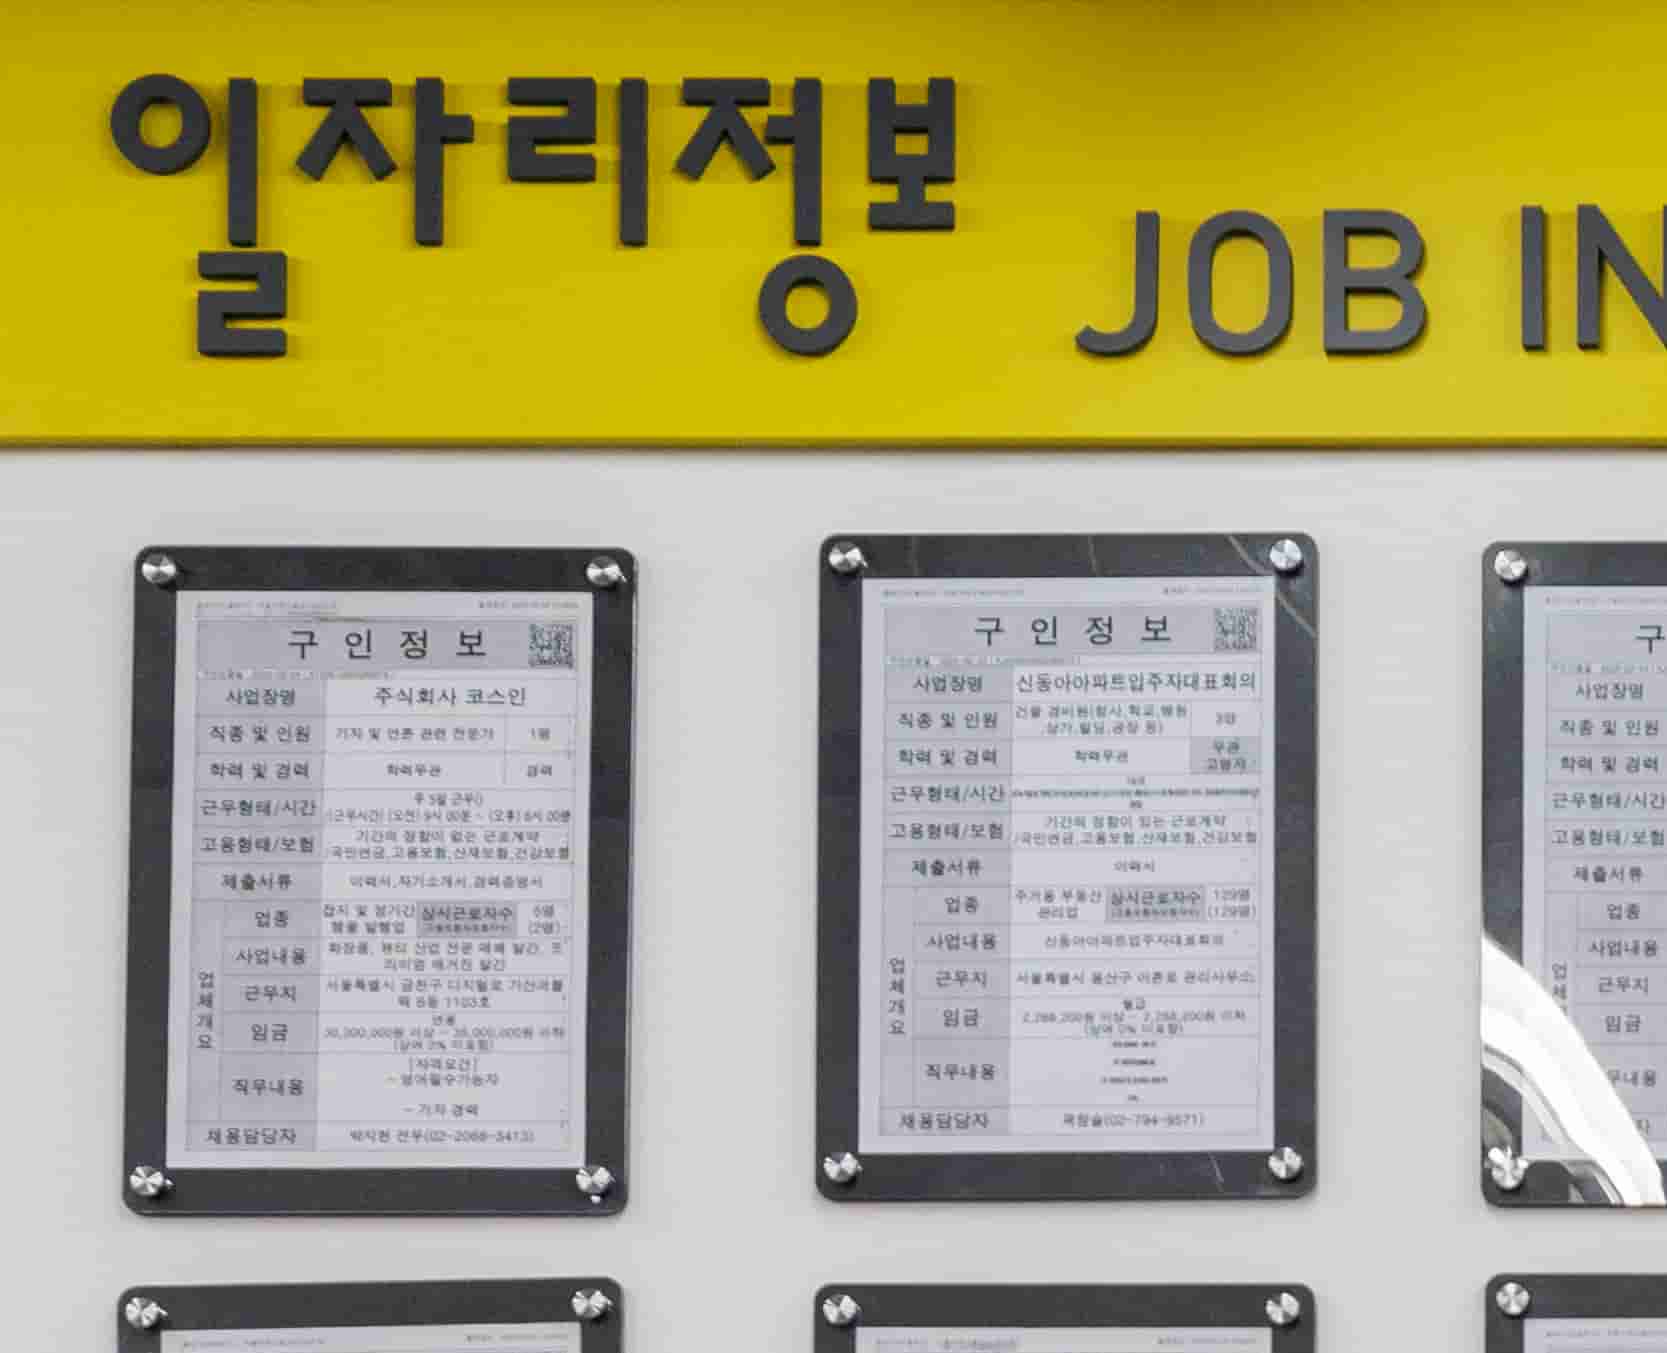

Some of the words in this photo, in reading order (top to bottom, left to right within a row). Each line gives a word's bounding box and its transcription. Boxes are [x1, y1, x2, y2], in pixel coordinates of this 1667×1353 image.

[110, 73, 959, 361] 일자리정보
[1076, 208, 1428, 358] JOB
[911, 673, 983, 694] 사업장명
[1575, 681, 1644, 702] 사업장명
[225, 687, 296, 707] 사업장명
[374, 686, 457, 708] 주식회사
[463, 687, 526, 707] 코스인
[890, 783, 1006, 804] 근무형태/시간
[199, 799, 317, 817] 근무형태/시간
[888, 821, 1004, 841] 고용형태/보험
[1551, 827, 1665, 848] 고용형태/보험
[199, 836, 315, 854] 고용형태/보험
